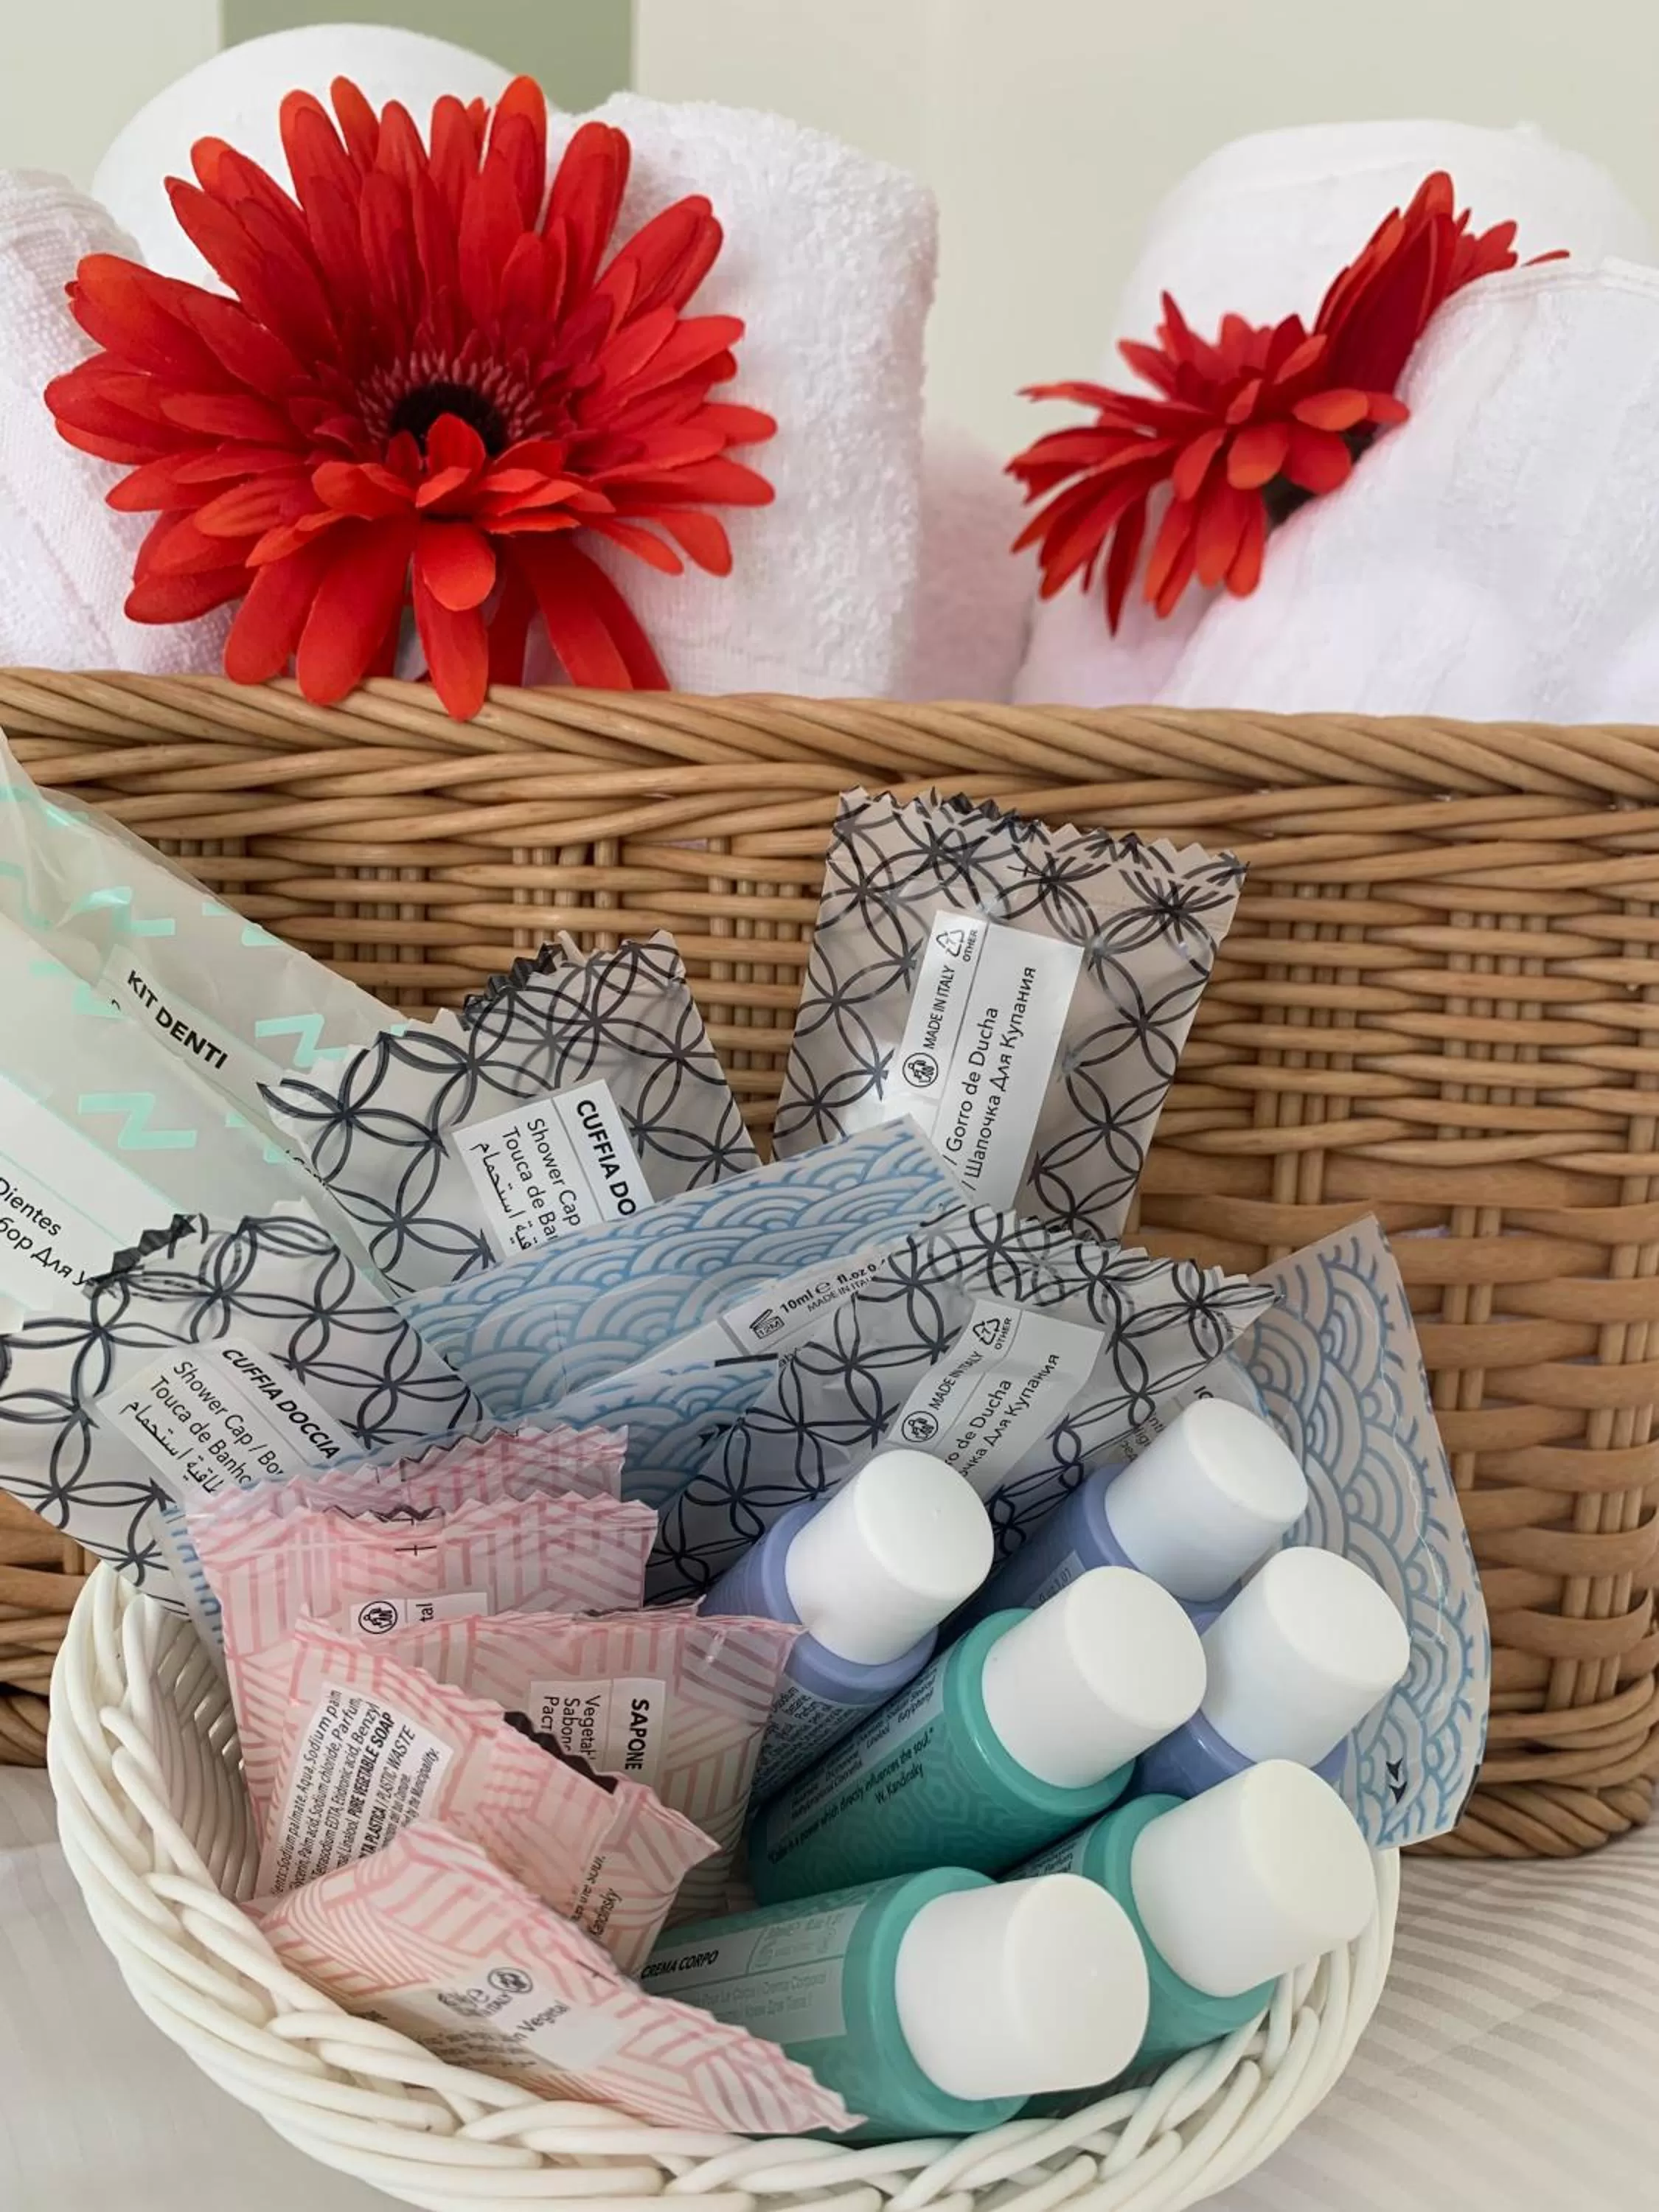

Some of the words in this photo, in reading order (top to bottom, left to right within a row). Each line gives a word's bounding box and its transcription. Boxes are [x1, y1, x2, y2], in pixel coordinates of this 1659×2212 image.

[962, 929, 978, 962] OTHER
[933, 995, 947, 1015] IN
[938, 965, 956, 1001] ITALY
[127, 970, 159, 1009] KIT
[154, 1005, 229, 1070] DENTI
[922, 1013, 943, 1050] MADE
[967, 1007, 998, 1066] Ducha
[961, 1074, 981, 1096] de
[964, 1096, 1001, 1179] Шапочка
[989, 1054, 1012, 1093] Для
[1001, 967, 1036, 1050] Купания
[576, 1099, 622, 1180] CUFFIA
[945, 1100, 973, 1152] Gorro
[502, 1126, 534, 1183] Touca
[526, 1185, 547, 1209] de
[526, 1118, 566, 1186] Shower
[558, 1189, 581, 1226] Cap
[29, 1246, 73, 1279] Для
[779, 1288, 815, 1314] 10ml
[807, 1291, 838, 1312] MADE
[837, 1285, 850, 1296] IN
[993, 1316, 1012, 1350] OTHER
[149, 1375, 192, 1423] Touca
[189, 1419, 213, 1444] de
[173, 1360, 228, 1416] Shower
[224, 1413, 253, 1446] Cap
[222, 1348, 285, 1402] CUFFIA
[276, 1399, 343, 1461] DOCCIA
[928, 1377, 956, 1411] MADE
[958, 1430, 978, 1450] de
[970, 1379, 1012, 1429] Ducha
[983, 1418, 1012, 1447] Для
[1006, 1353, 1060, 1419] Купания
[302, 1715, 333, 1764] Sodium
[350, 1701, 381, 1745] Benzyl
[386, 1724, 416, 1771] WASTE
[625, 1698, 650, 1770] SAPONE
[352, 1745, 380, 1798] VEGETABLE
[370, 1711, 395, 1749] SOAP
[640, 1959, 678, 1980] CREMA
[678, 1949, 720, 1971] CORPO
